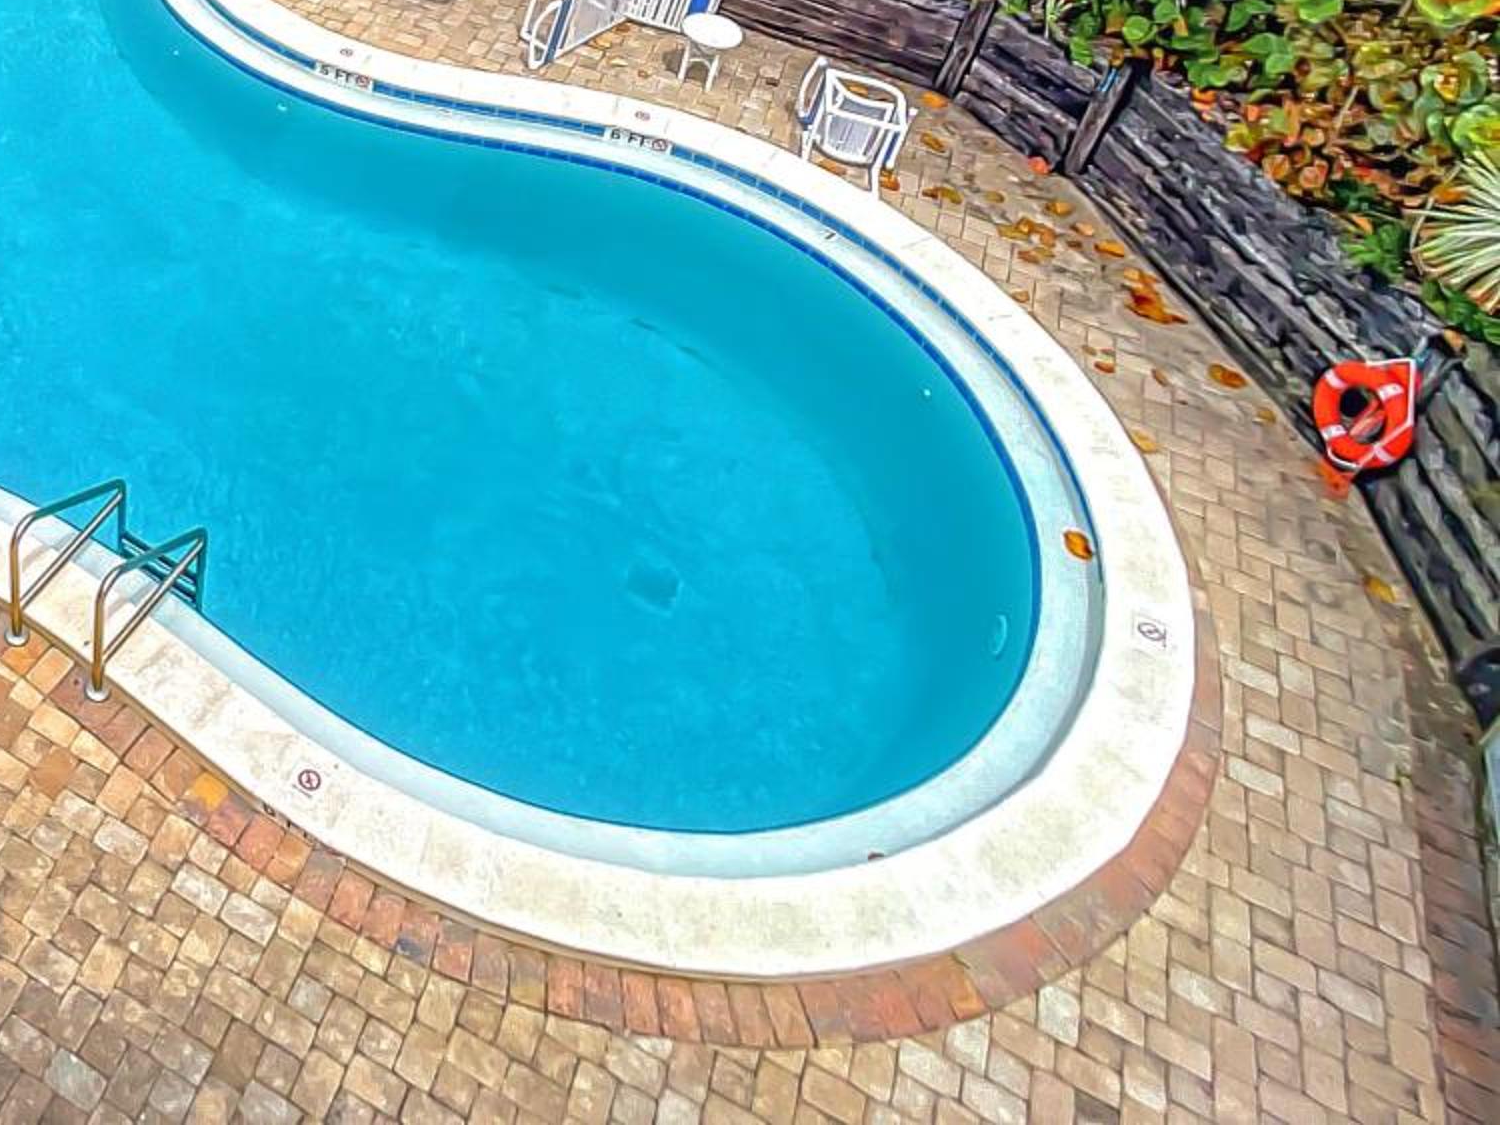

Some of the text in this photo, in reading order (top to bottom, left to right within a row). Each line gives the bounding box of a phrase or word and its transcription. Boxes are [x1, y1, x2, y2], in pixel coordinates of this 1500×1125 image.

[319, 63, 355, 83] 5 FT
[611, 127, 648, 147] 6 FT
